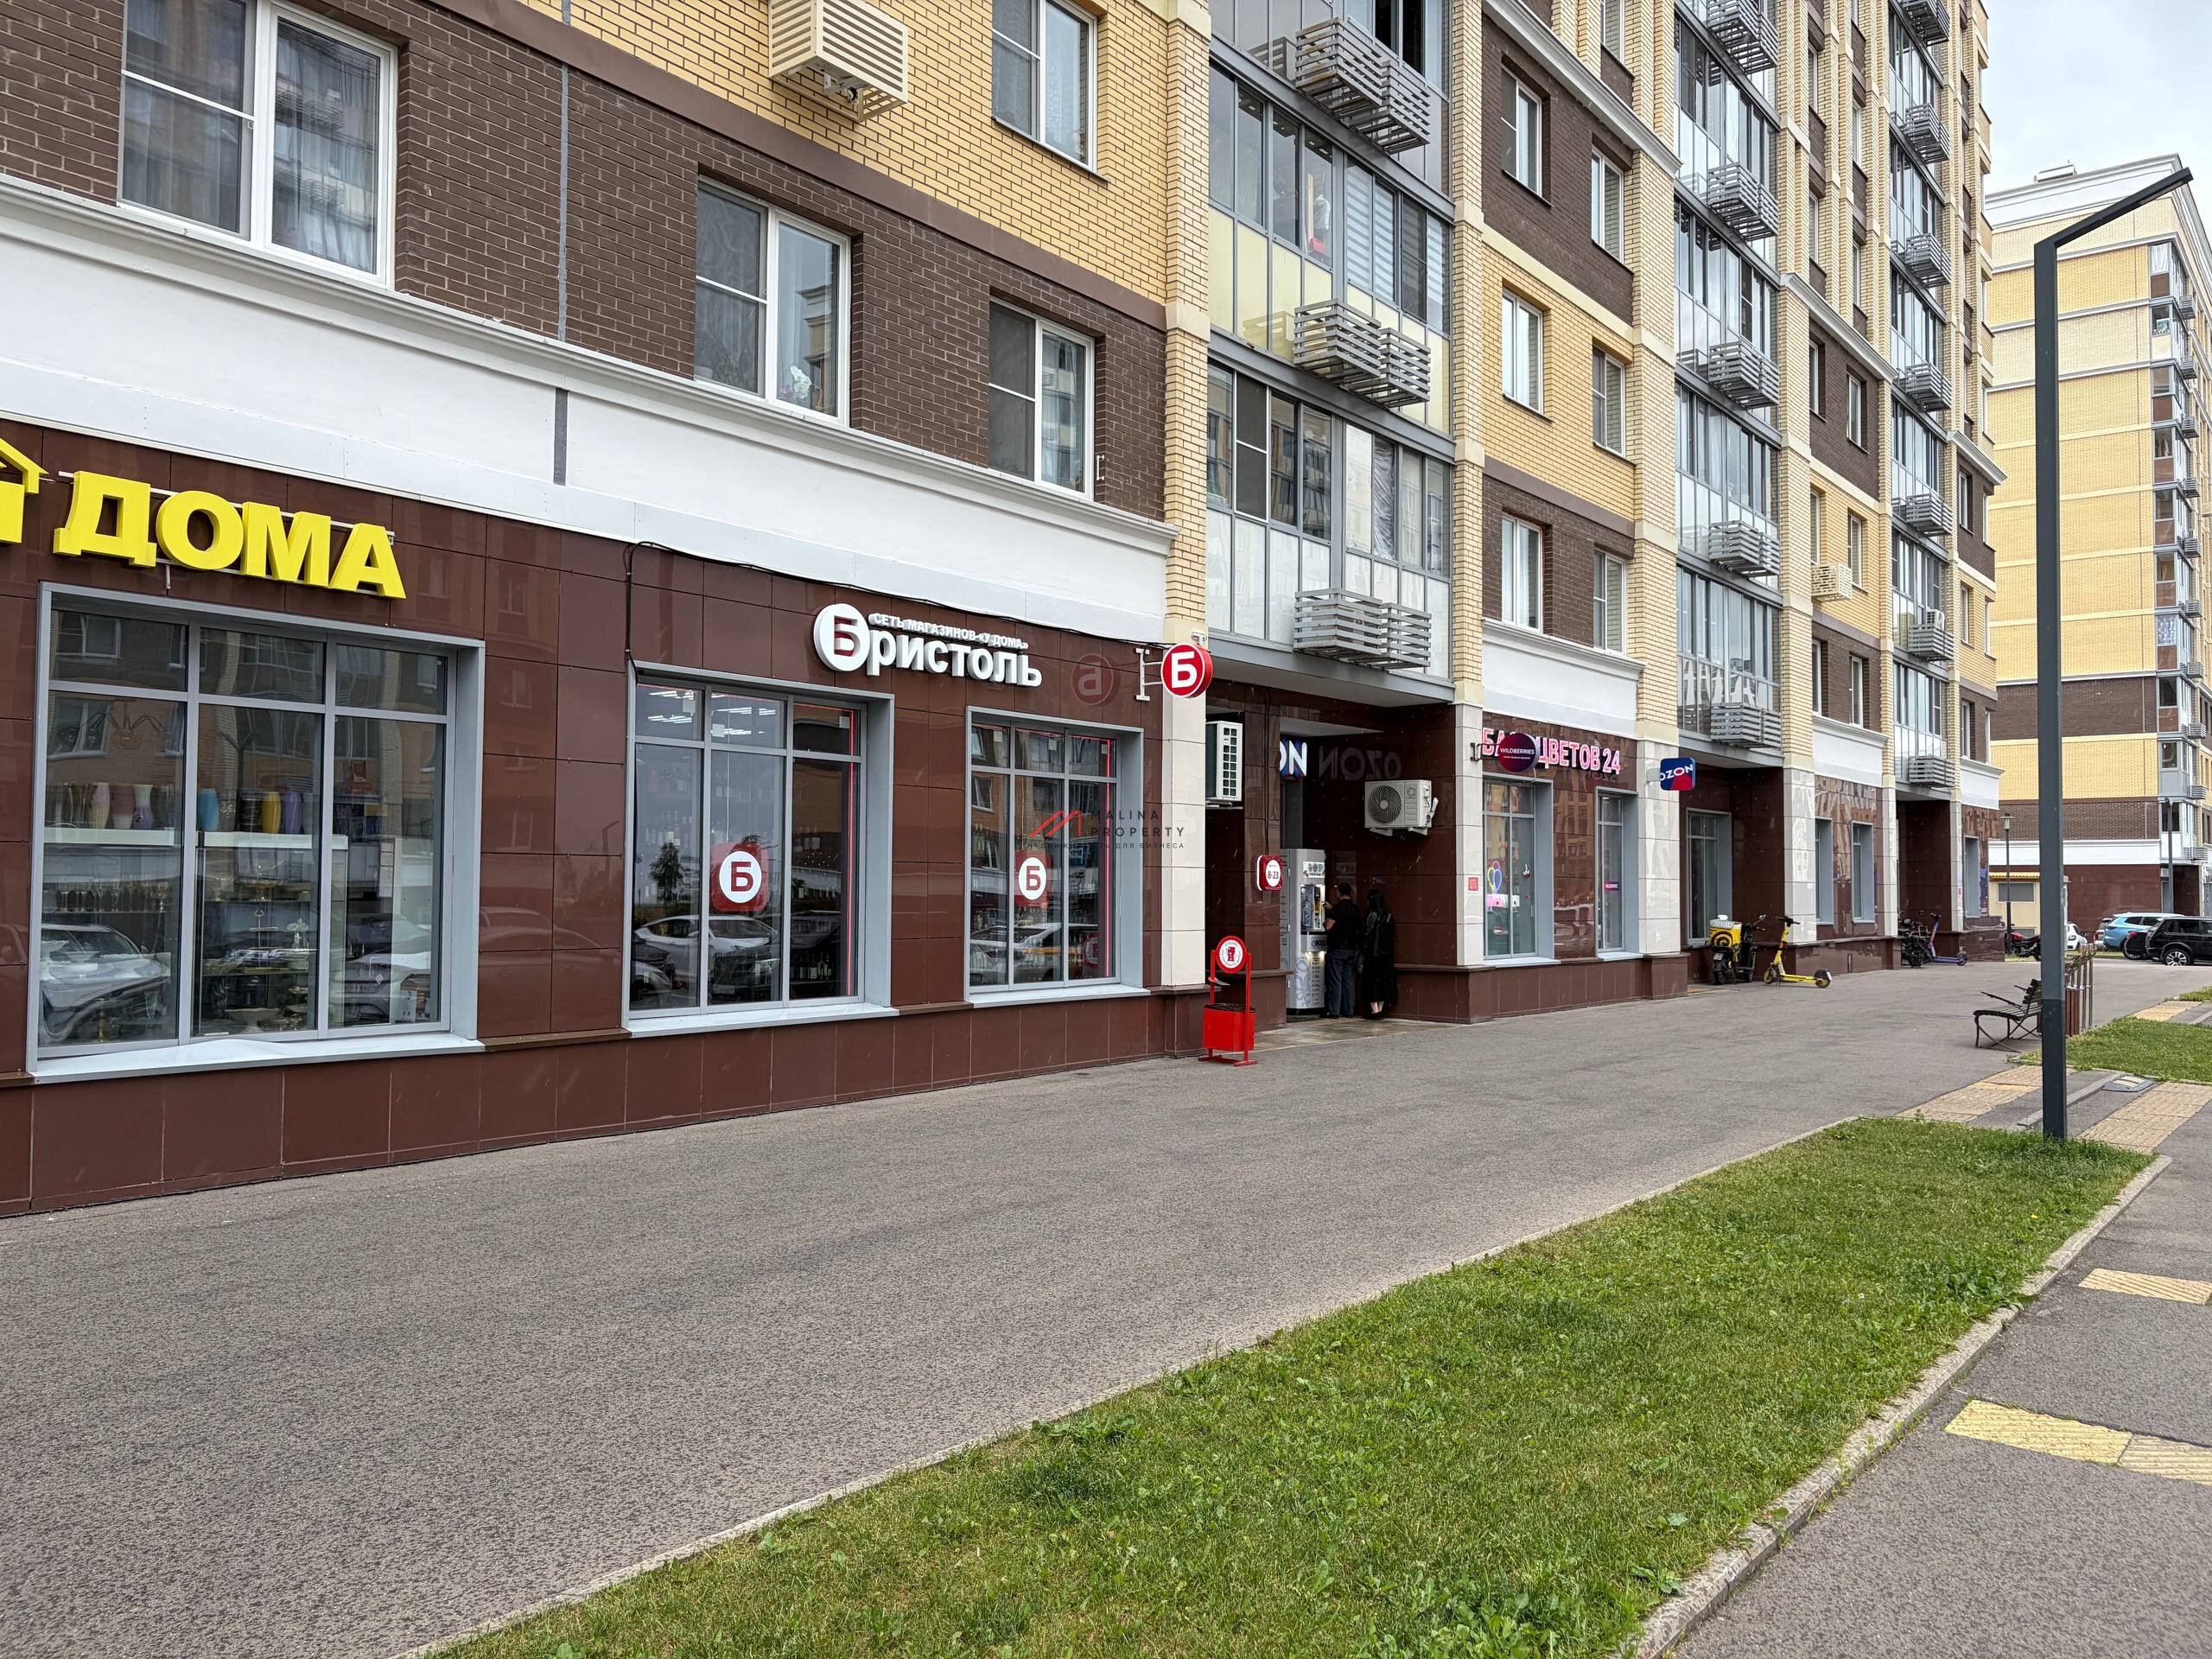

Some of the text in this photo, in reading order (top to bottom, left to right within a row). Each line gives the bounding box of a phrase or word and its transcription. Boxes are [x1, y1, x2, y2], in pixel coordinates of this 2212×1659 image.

[53, 470, 406, 599] ДОМА
[868, 613, 905, 629] СЕТЬ
[905, 619, 976, 641] МАГАЗИНОВ
[1171, 652, 1198, 689] Б
[1536, 736, 1600, 771] ЦВЕТОВ
[1603, 748, 1621, 774] 24
[1660, 764, 1693, 781] OZON
[731, 861, 754, 893] Б
[1026, 865, 1041, 891] Б
